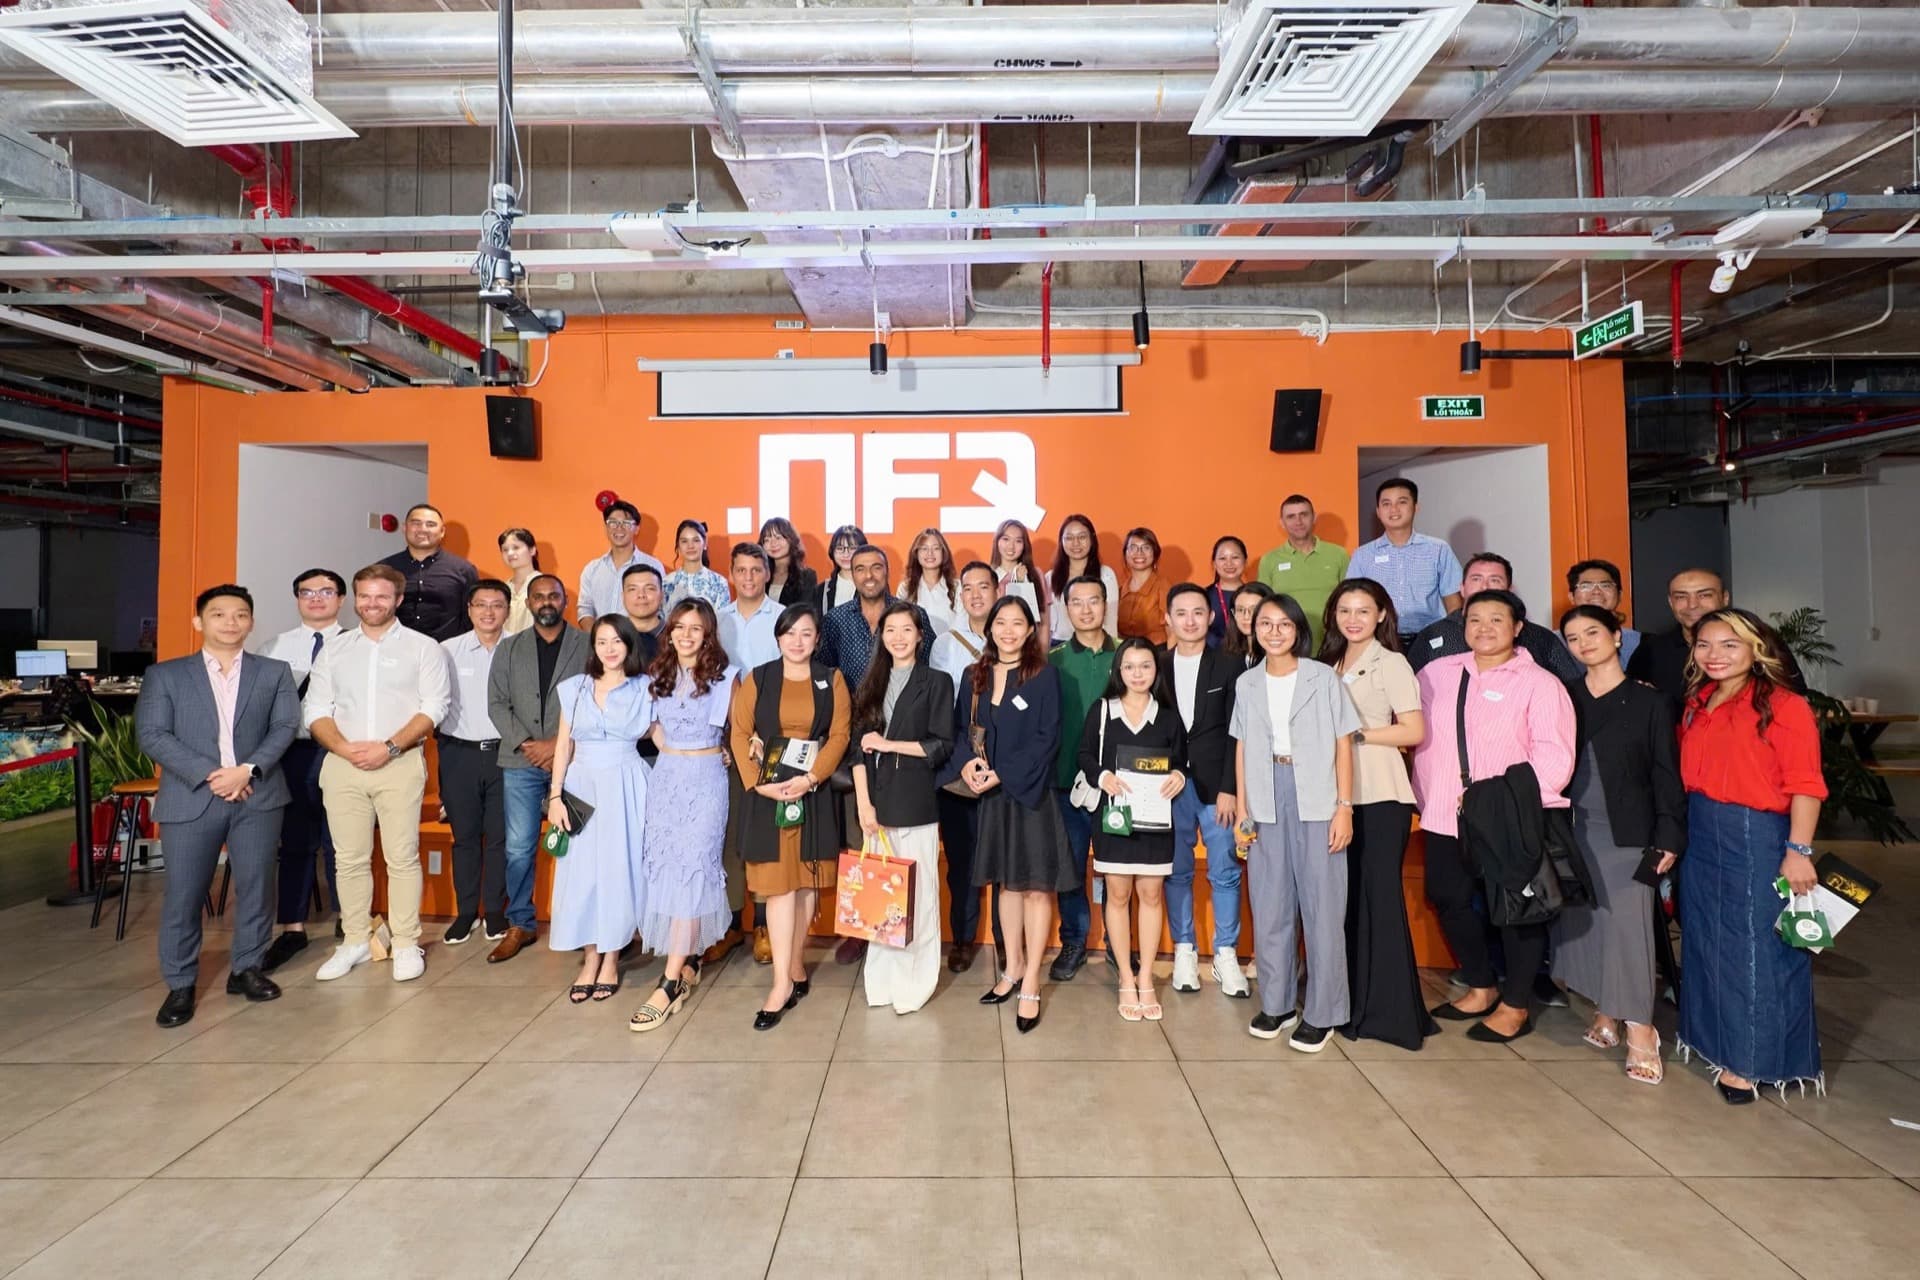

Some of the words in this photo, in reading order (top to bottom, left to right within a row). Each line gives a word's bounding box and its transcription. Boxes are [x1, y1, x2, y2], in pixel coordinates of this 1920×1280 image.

[993, 59, 1045, 68] CHWS
[1609, 326, 1628, 341] EXIT
[1437, 399, 1470, 408] EXIT
[1448, 407, 1474, 416] THOÁT
